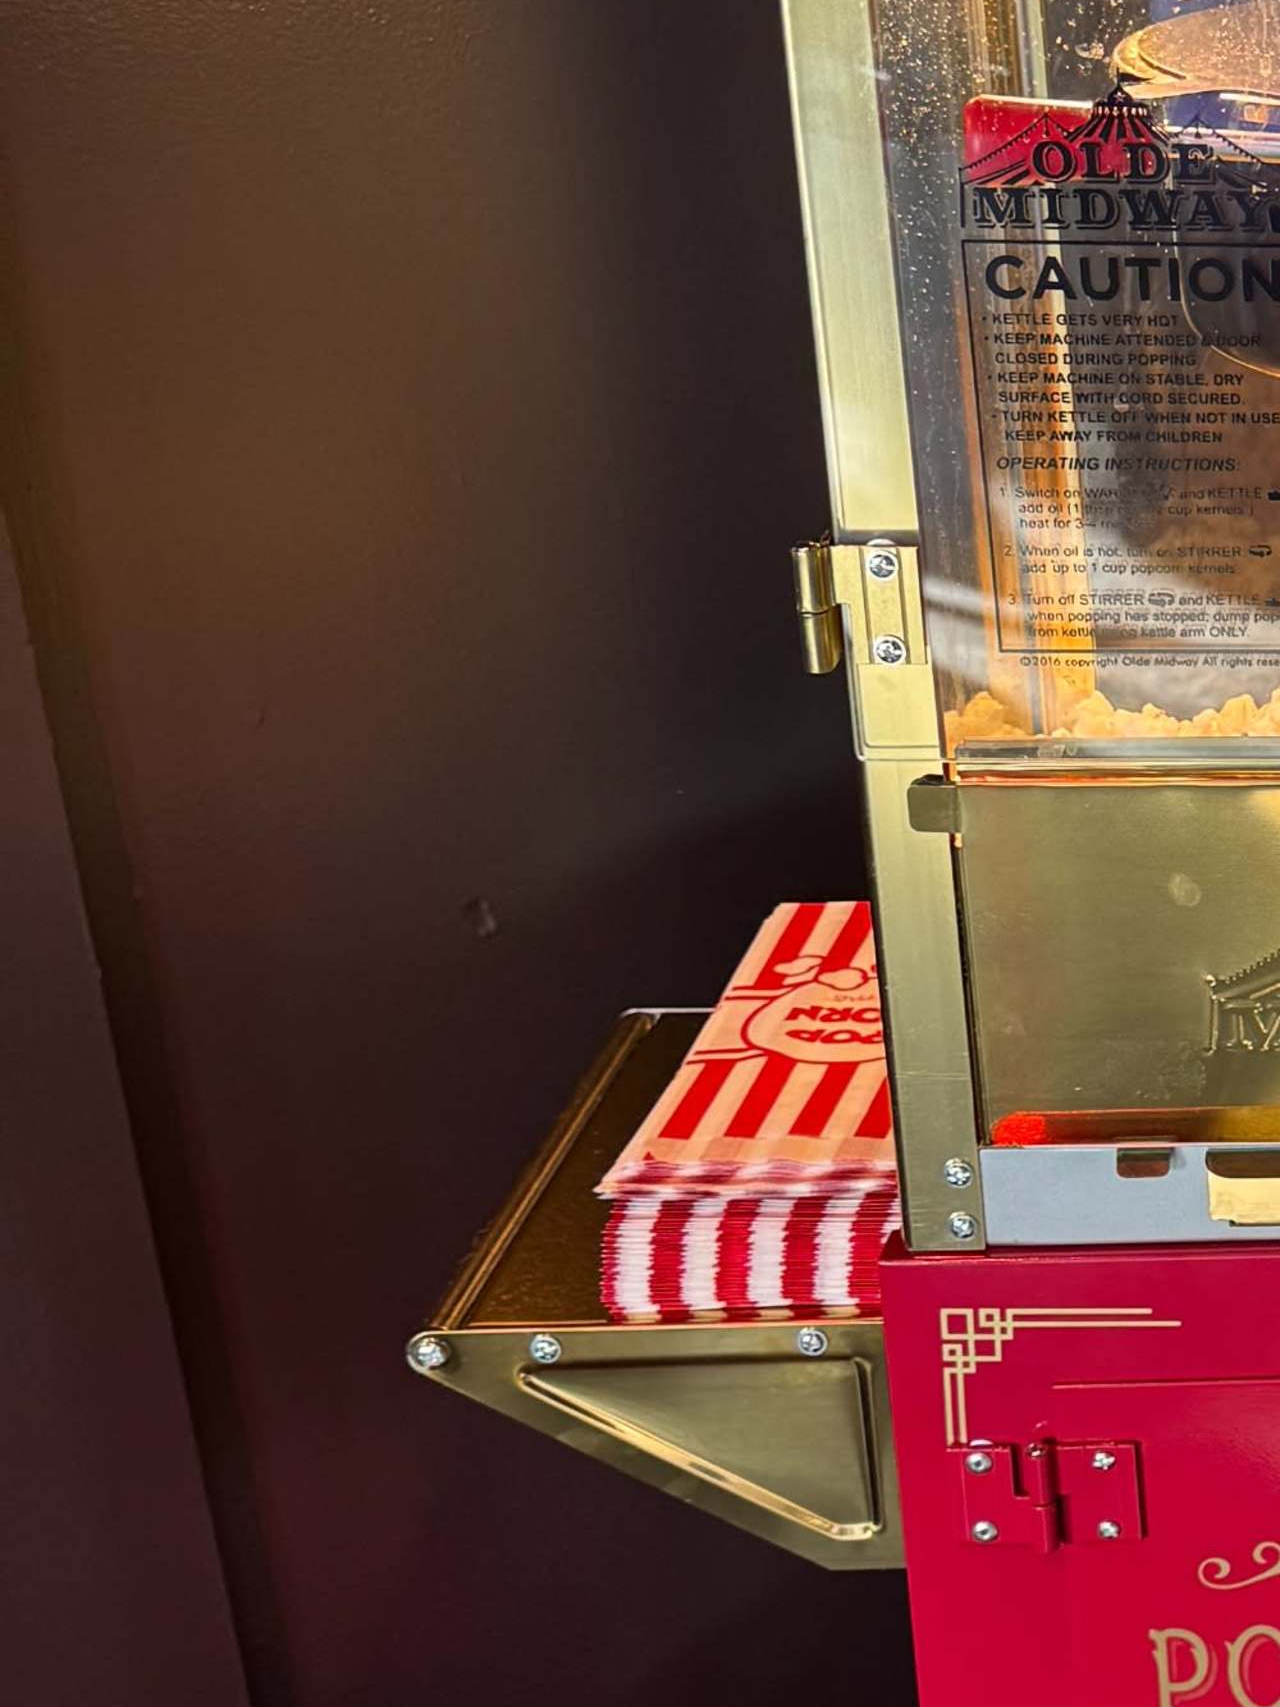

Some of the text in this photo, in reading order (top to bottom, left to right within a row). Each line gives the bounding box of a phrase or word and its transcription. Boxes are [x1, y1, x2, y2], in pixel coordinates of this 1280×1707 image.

[1032, 141, 1218, 185] OLDE
[973, 188, 1279, 232] MIDWAY
[993, 313, 1178, 326] KETTLE GETS VERY HOT
[994, 333, 1036, 345] KEEP
[1040, 333, 1112, 345] MACHINE
[1115, 334, 1199, 346] ATTENDED
[995, 353, 1197, 366] CLOSED DURING POPPING
[998, 372, 1038, 384] KEEP
[1043, 373, 1113, 384] MACHINE
[1119, 373, 1140, 385] ON
[1213, 374, 1244, 386] DRY
[998, 391, 1071, 403] SURFACE
[1077, 392, 1116, 403] WITH
[1119, 392, 1164, 404] CORD
[1002, 411, 1043, 423] TURN
[1048, 411, 1107, 423] KETTLE
[1111, 412, 1137, 423] OFF
[1145, 412, 1191, 424] WHEN
[1196, 412, 1229, 424] NOT
[1232, 413, 1247, 424] IN
[1005, 430, 1223, 443] KEEP AWAY FROM CHILDREN
[997, 457, 1100, 471] OPERATING
[1015, 486, 1059, 498] Switch
[1063, 489, 1080, 498] on
[1019, 503, 1043, 513] add
[1168, 504, 1192, 516] cup
[1020, 517, 1049, 529] heat
[1053, 517, 1070, 528] for
[1063, 546, 1079, 557] oil
[1177, 546, 1241, 558] STIRRER
[1023, 563, 1046, 574] add
[1052, 564, 1069, 575] up
[1073, 563, 1087, 573] to
[1101, 564, 1127, 575] cup
[1024, 594, 1055, 605] Turn
[1058, 593, 1075, 605] off
[1079, 593, 1145, 606] STIRRER
[1178, 594, 1203, 606] and
[1206, 594, 1262, 606] KETTLE
[1027, 612, 1064, 622] when
[1068, 611, 1121, 624] popping
[1125, 610, 1149, 622] has
[1213, 611, 1250, 624] dump
[1028, 626, 1058, 637] from
[1140, 626, 1176, 638] kettle
[1180, 627, 1206, 638] arm
[1065, 656, 1118, 668] copyright
[1122, 655, 1150, 667] Olde
[1153, 656, 1198, 668] Midway
[1202, 656, 1218, 667] All
[1221, 656, 1253, 668] rights
[785, 1007, 882, 1021] ORN
